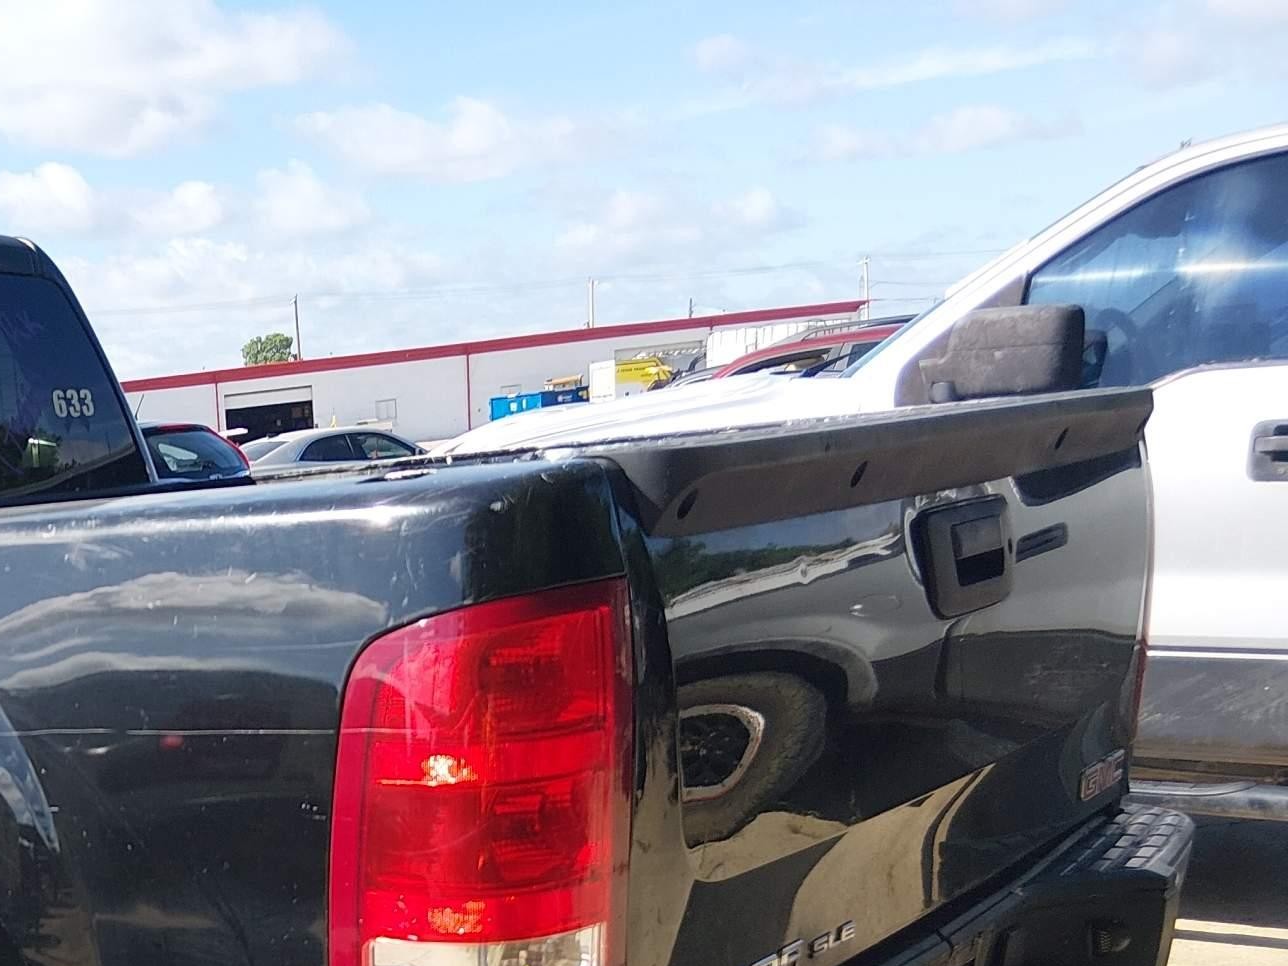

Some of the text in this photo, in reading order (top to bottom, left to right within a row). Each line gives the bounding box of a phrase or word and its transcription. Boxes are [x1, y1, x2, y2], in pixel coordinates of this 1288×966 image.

[52, 388, 95, 418] 633
[1080, 749, 1126, 801] GMC
[810, 919, 857, 959] SLE
